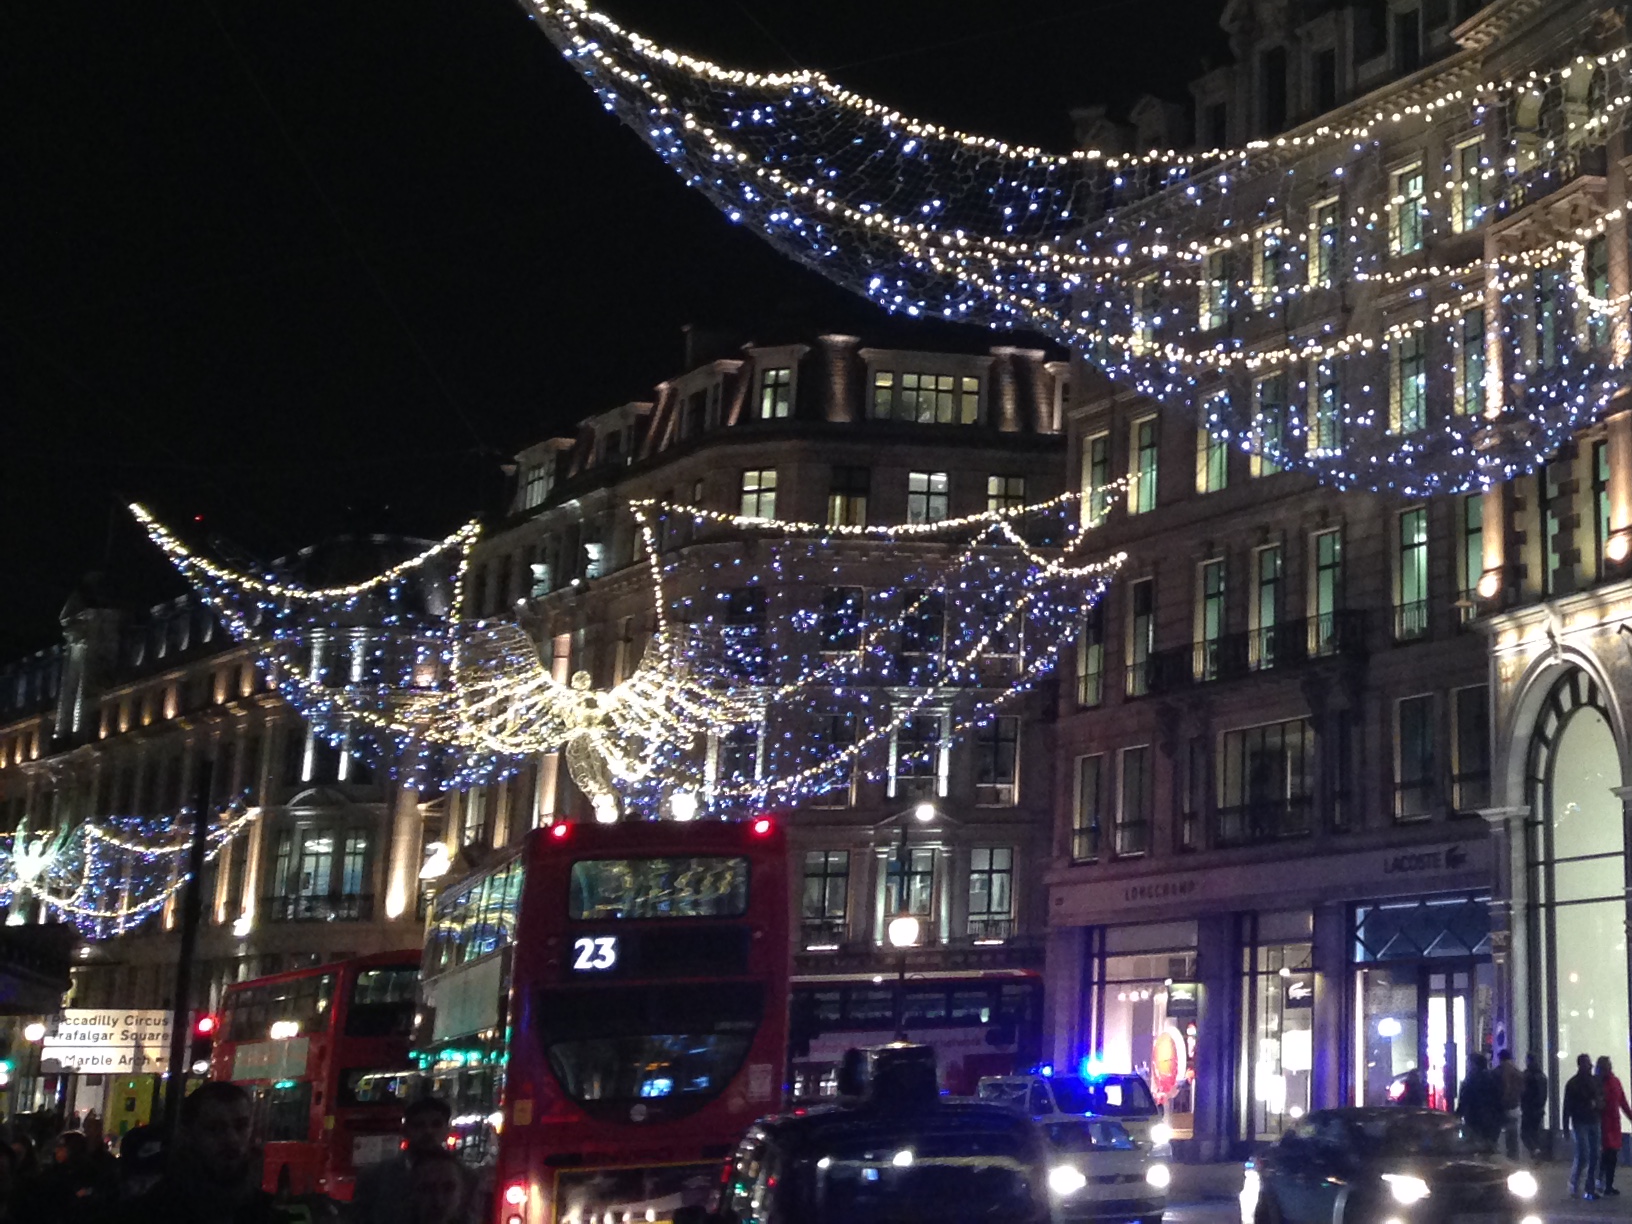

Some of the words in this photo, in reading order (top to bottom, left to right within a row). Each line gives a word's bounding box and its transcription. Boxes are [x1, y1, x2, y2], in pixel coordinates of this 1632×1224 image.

[573, 937, 616, 969] 23
[51, 1015, 119, 1027] Piccadilly
[125, 1015, 169, 1026] Circus
[51, 1029, 115, 1042] Trafalgar
[120, 1029, 169, 1042] Square
[64, 1055, 113, 1066] Marble
[118, 1055, 150, 1066] Arch
